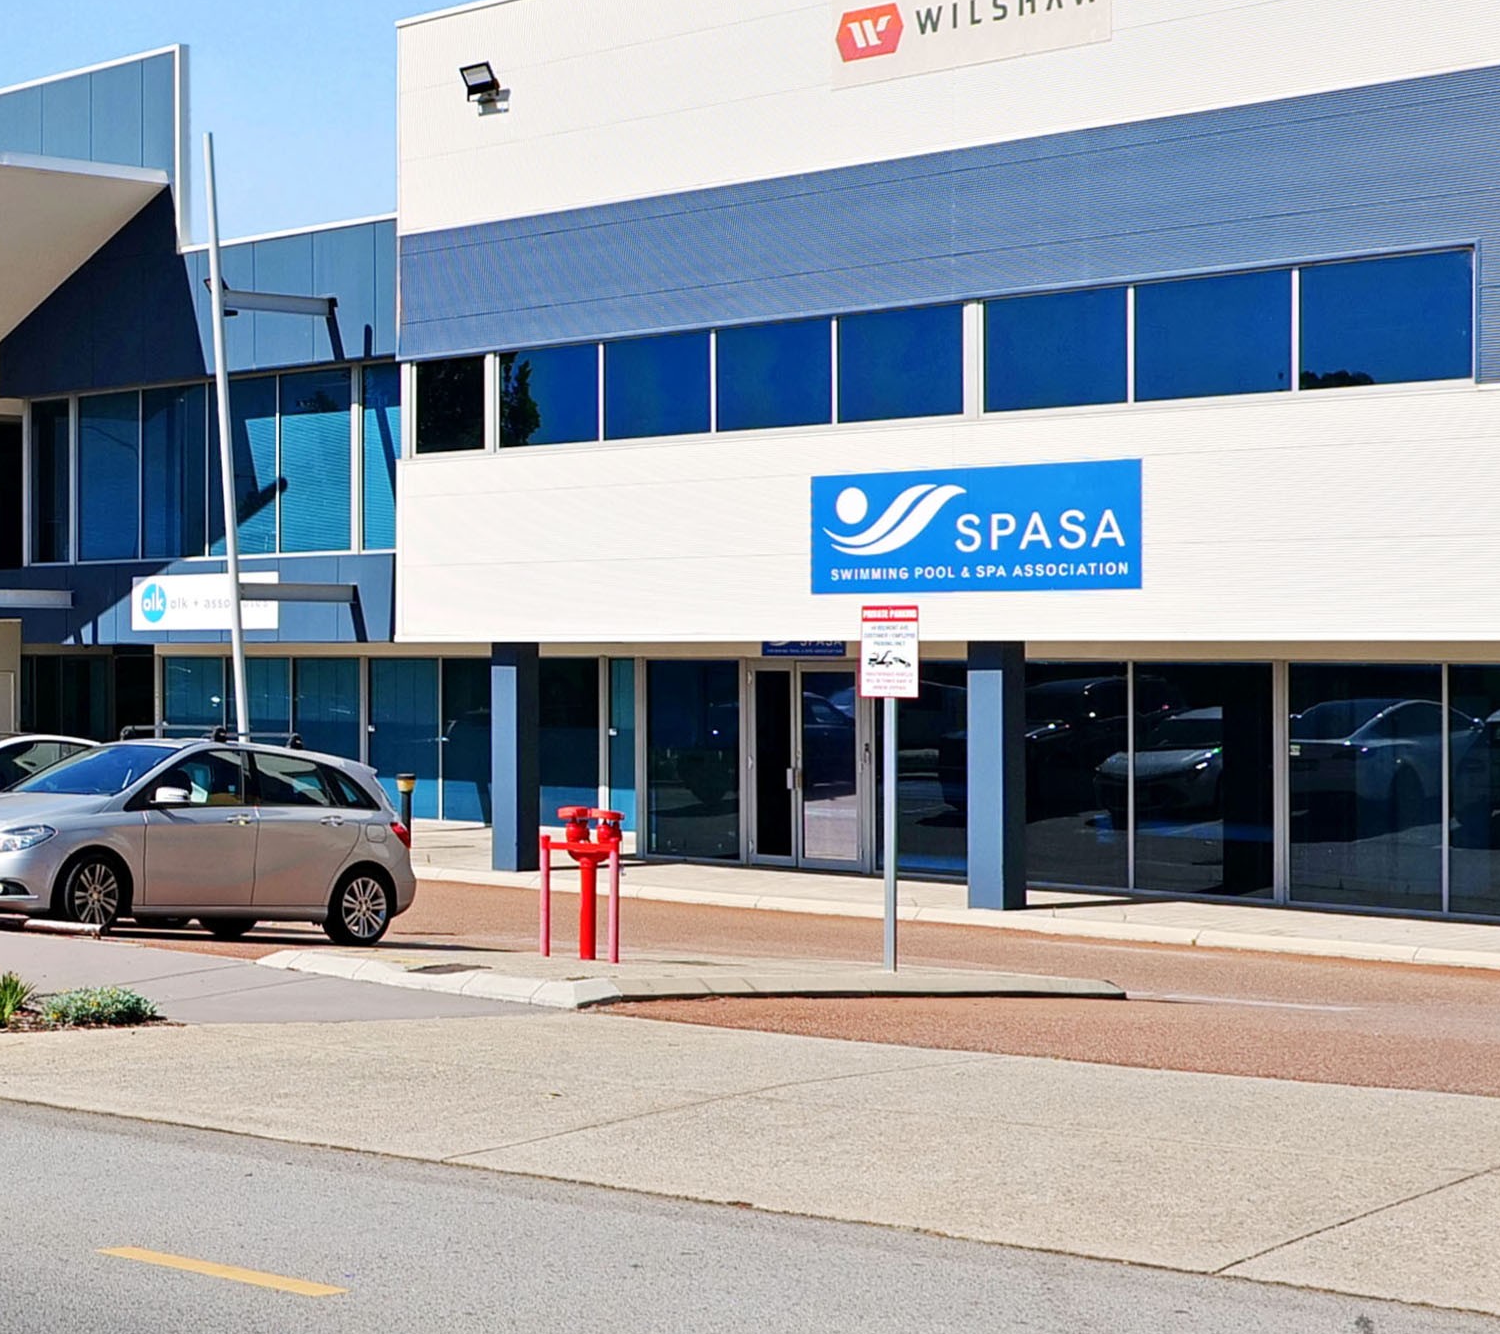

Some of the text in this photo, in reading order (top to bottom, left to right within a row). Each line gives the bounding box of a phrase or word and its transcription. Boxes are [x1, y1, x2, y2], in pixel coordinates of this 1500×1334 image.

[955, 509, 1126, 553] SPASA
[830, 561, 1129, 581] SWIMMING POOL & SPA ASSOCIATION
